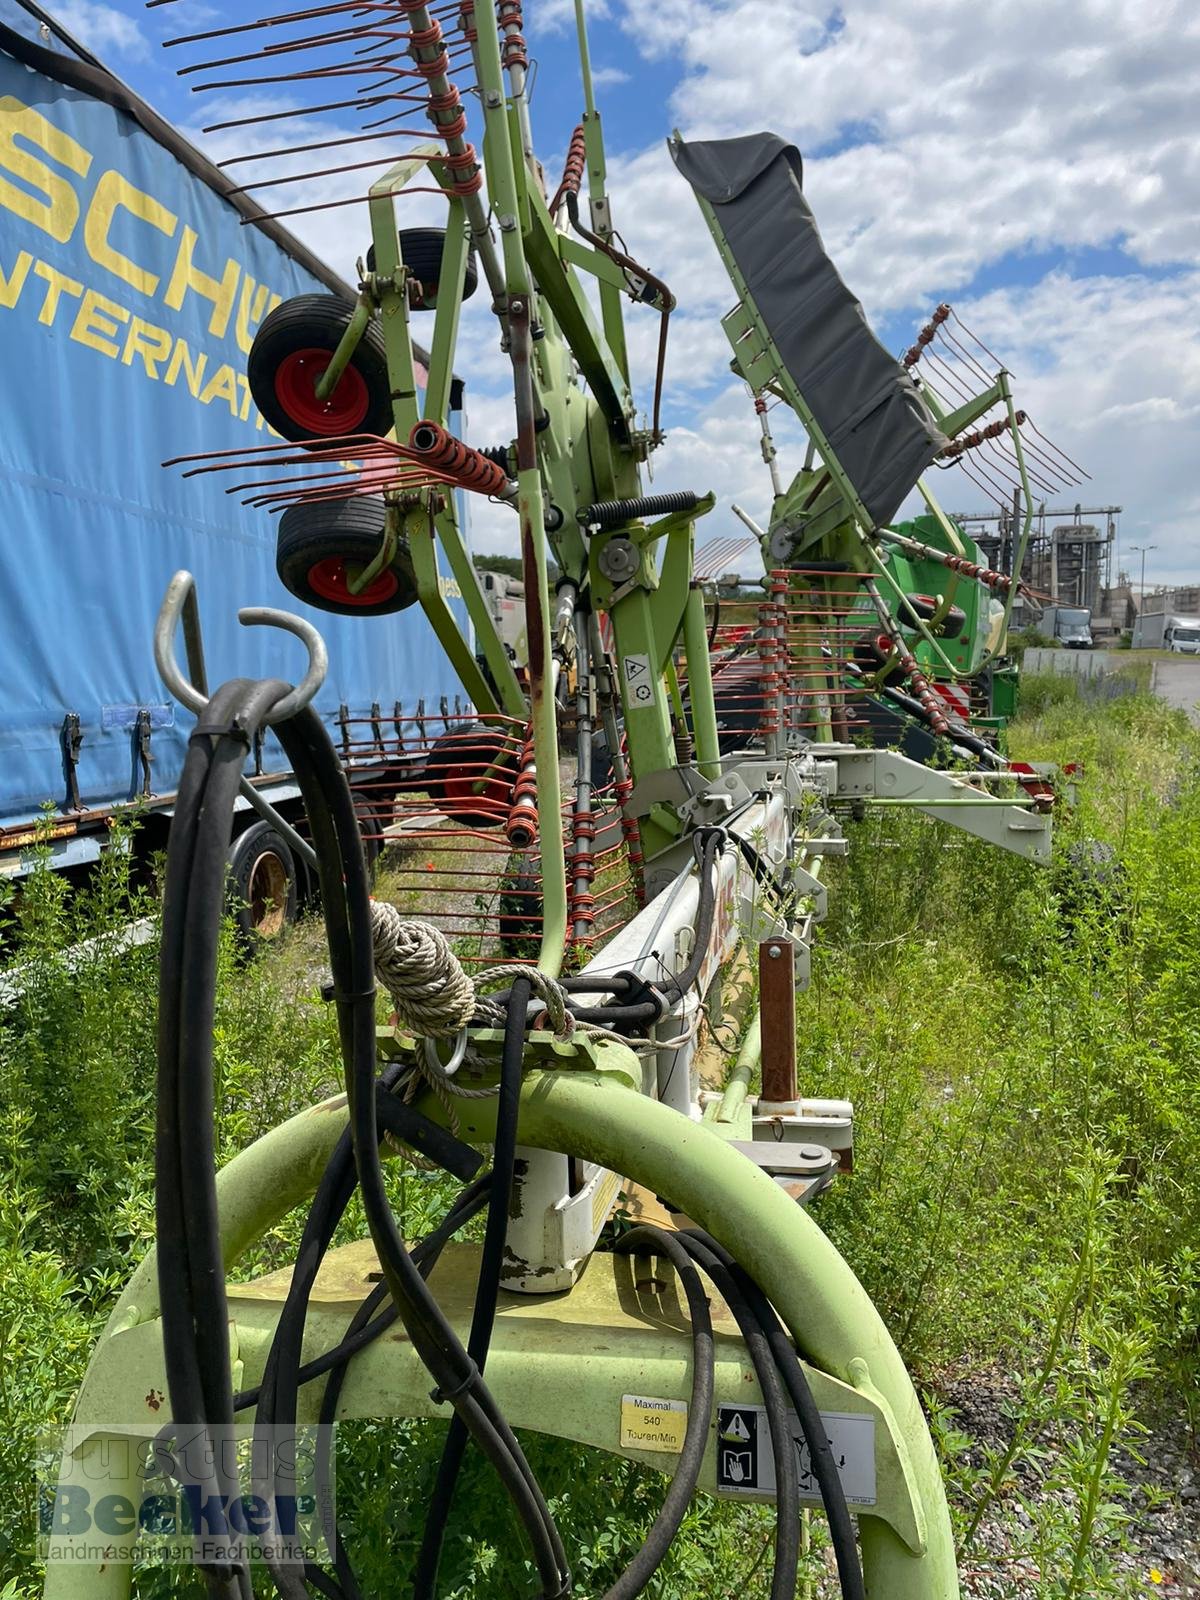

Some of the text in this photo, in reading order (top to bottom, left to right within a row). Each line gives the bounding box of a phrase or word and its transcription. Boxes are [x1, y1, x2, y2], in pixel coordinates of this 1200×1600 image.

[634, 1399, 671, 1411] Maximal
[643, 1415, 661, 1426] 540
[627, 1428, 677, 1443] Touren/Min
